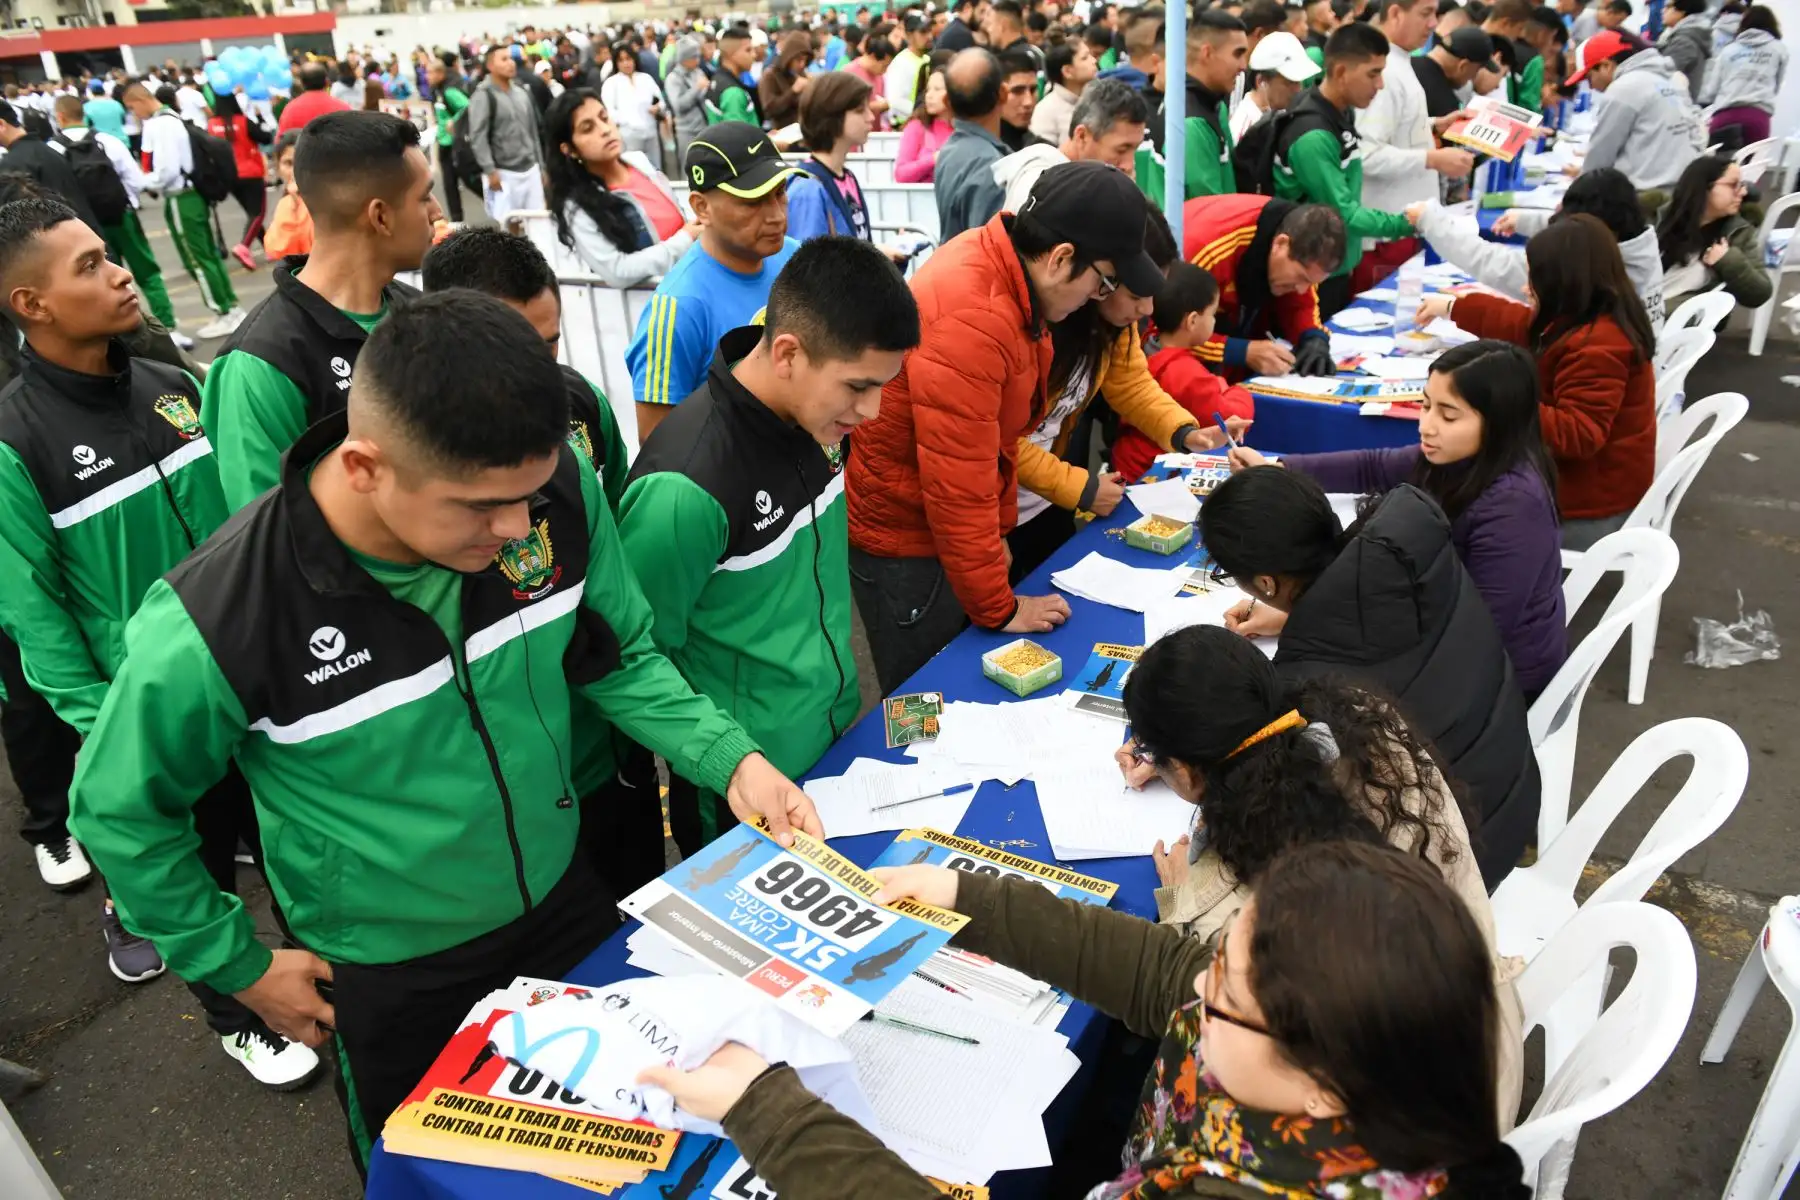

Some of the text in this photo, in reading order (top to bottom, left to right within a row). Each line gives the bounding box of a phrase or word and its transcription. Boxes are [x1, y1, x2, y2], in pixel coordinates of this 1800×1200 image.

[74, 456, 115, 481] WALON
[752, 504, 785, 532] WALON
[303, 647, 373, 685] WALON
[924, 831, 985, 856] PERSONAS
[984, 850, 1001, 861] DE
[821, 850, 841, 873] DE
[1000, 855, 1039, 872] TRATA
[1039, 866, 1056, 877] LA
[836, 862, 880, 897] TRATA
[1054, 870, 1108, 894] CONTRA
[724, 887, 791, 931] CORRE
[754, 860, 883, 939] 4966
[896, 900, 955, 927] CONTRA
[668, 910, 757, 968] Ministerio del Interior
[729, 907, 778, 942] LIMA
[774, 927, 848, 971] 5K
[760, 968, 793, 989] PERÚ
[628, 1012, 679, 1056] LIMA
[422, 1112, 484, 1137] CONTRA
[483, 1124, 505, 1141] LA
[505, 1127, 553, 1149] TRATA
[553, 1135, 576, 1152] DE
[434, 1092, 666, 1148] CONTRA LA TRATA DE PERSONAS
